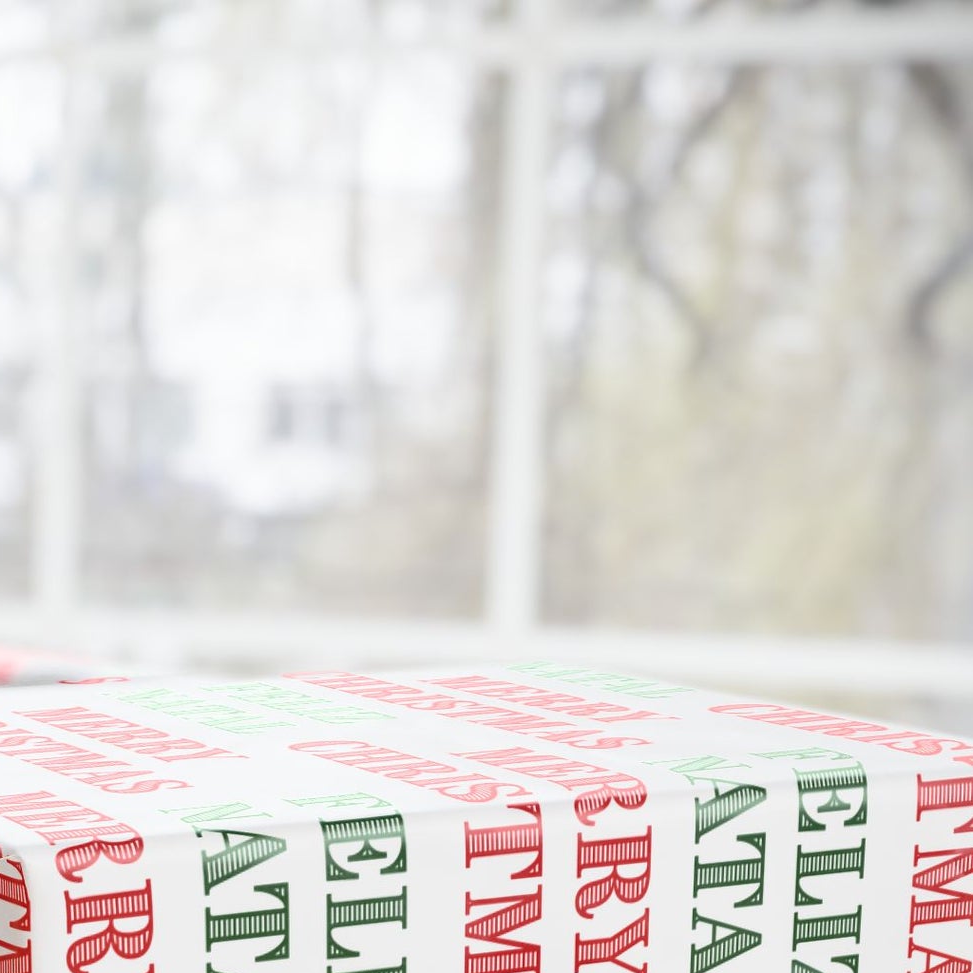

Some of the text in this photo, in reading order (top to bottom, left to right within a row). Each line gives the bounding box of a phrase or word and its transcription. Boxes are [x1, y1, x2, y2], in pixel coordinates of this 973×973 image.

[281, 671, 655, 752] CHRISTMAS
[417, 675, 683, 722] MERRY
[13, 706, 250, 763] MERRY
